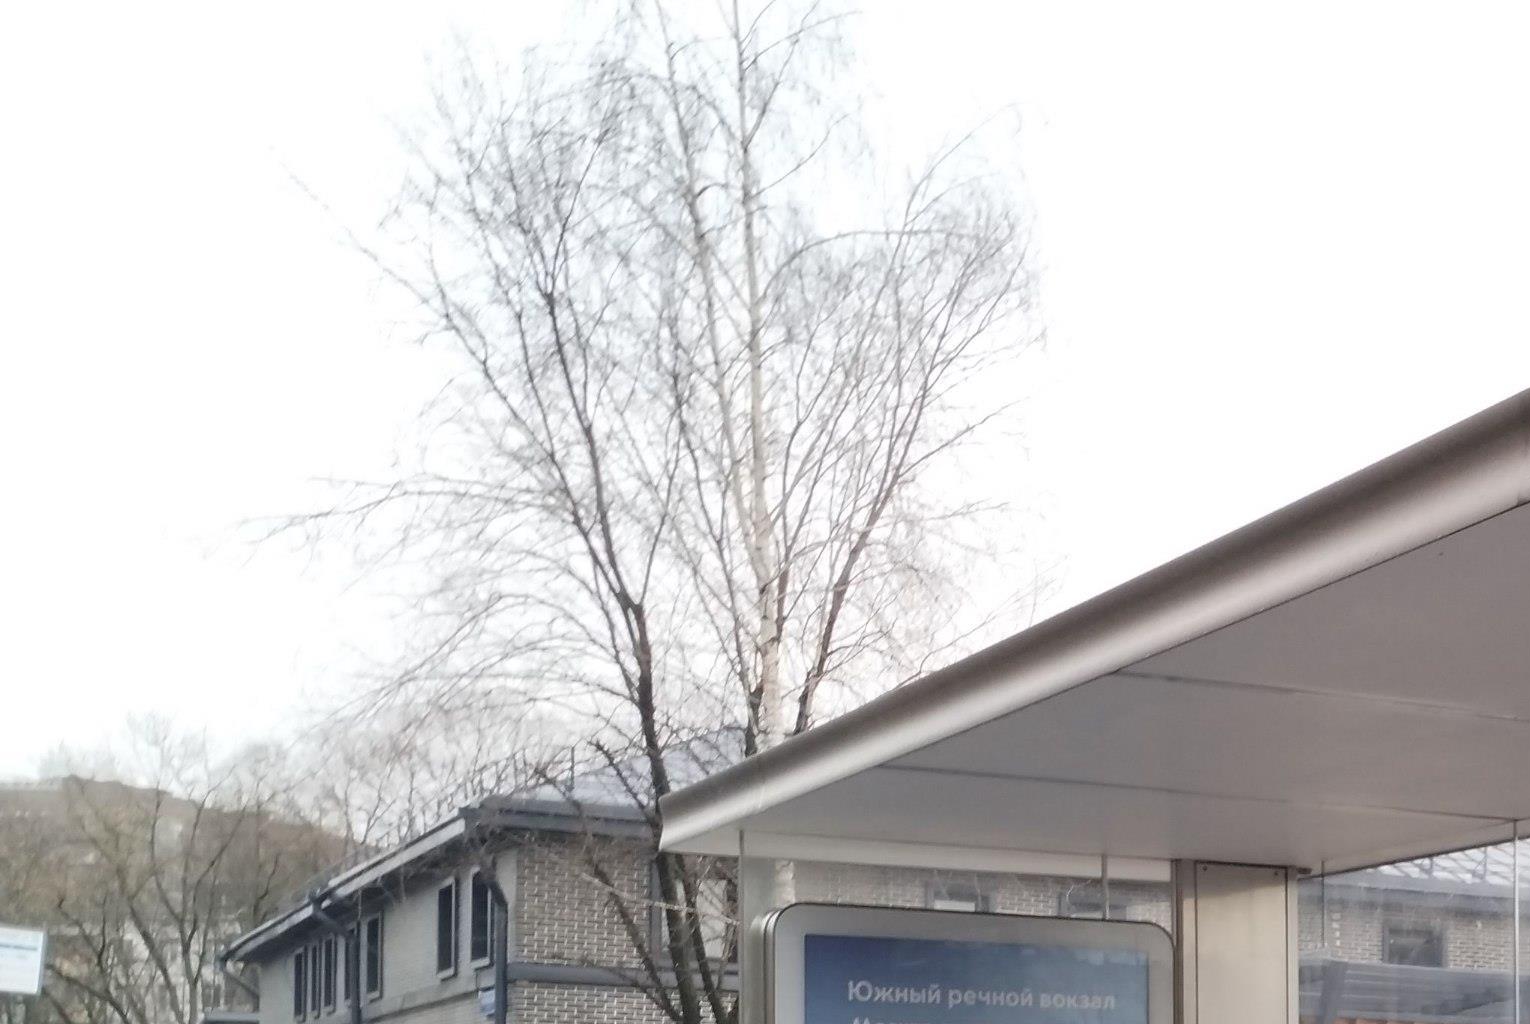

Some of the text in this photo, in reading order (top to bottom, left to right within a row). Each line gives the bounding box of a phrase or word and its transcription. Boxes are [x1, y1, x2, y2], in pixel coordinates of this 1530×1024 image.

[847, 979, 1117, 1011] Южный речной вокзал
